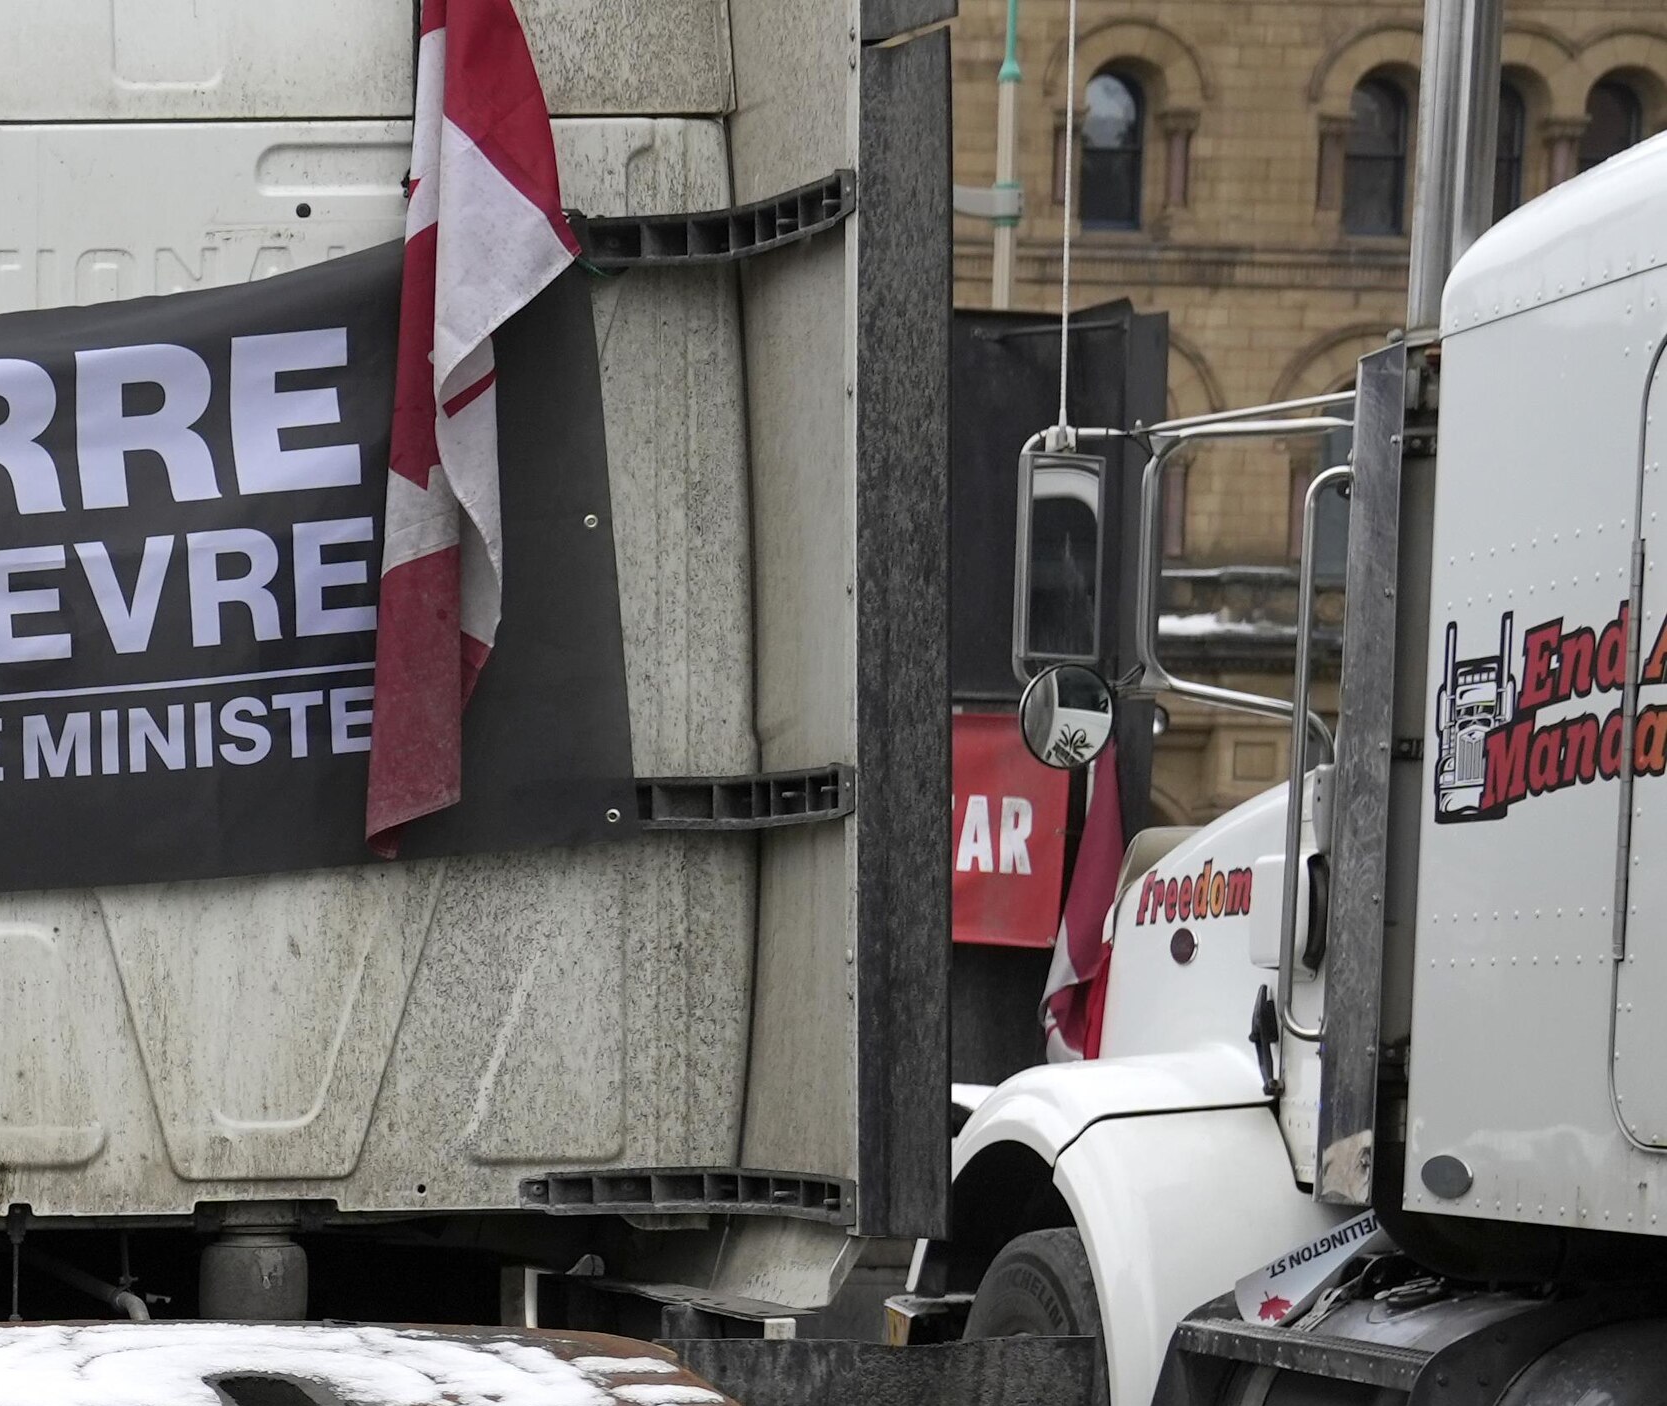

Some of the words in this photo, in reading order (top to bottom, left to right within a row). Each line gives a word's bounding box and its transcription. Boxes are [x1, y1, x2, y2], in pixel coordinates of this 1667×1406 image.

[1517, 599, 1630, 711] End
[22, 685, 375, 780] MINISTE
[1480, 700, 1667, 811] Manda
[952, 794, 1033, 875] AR
